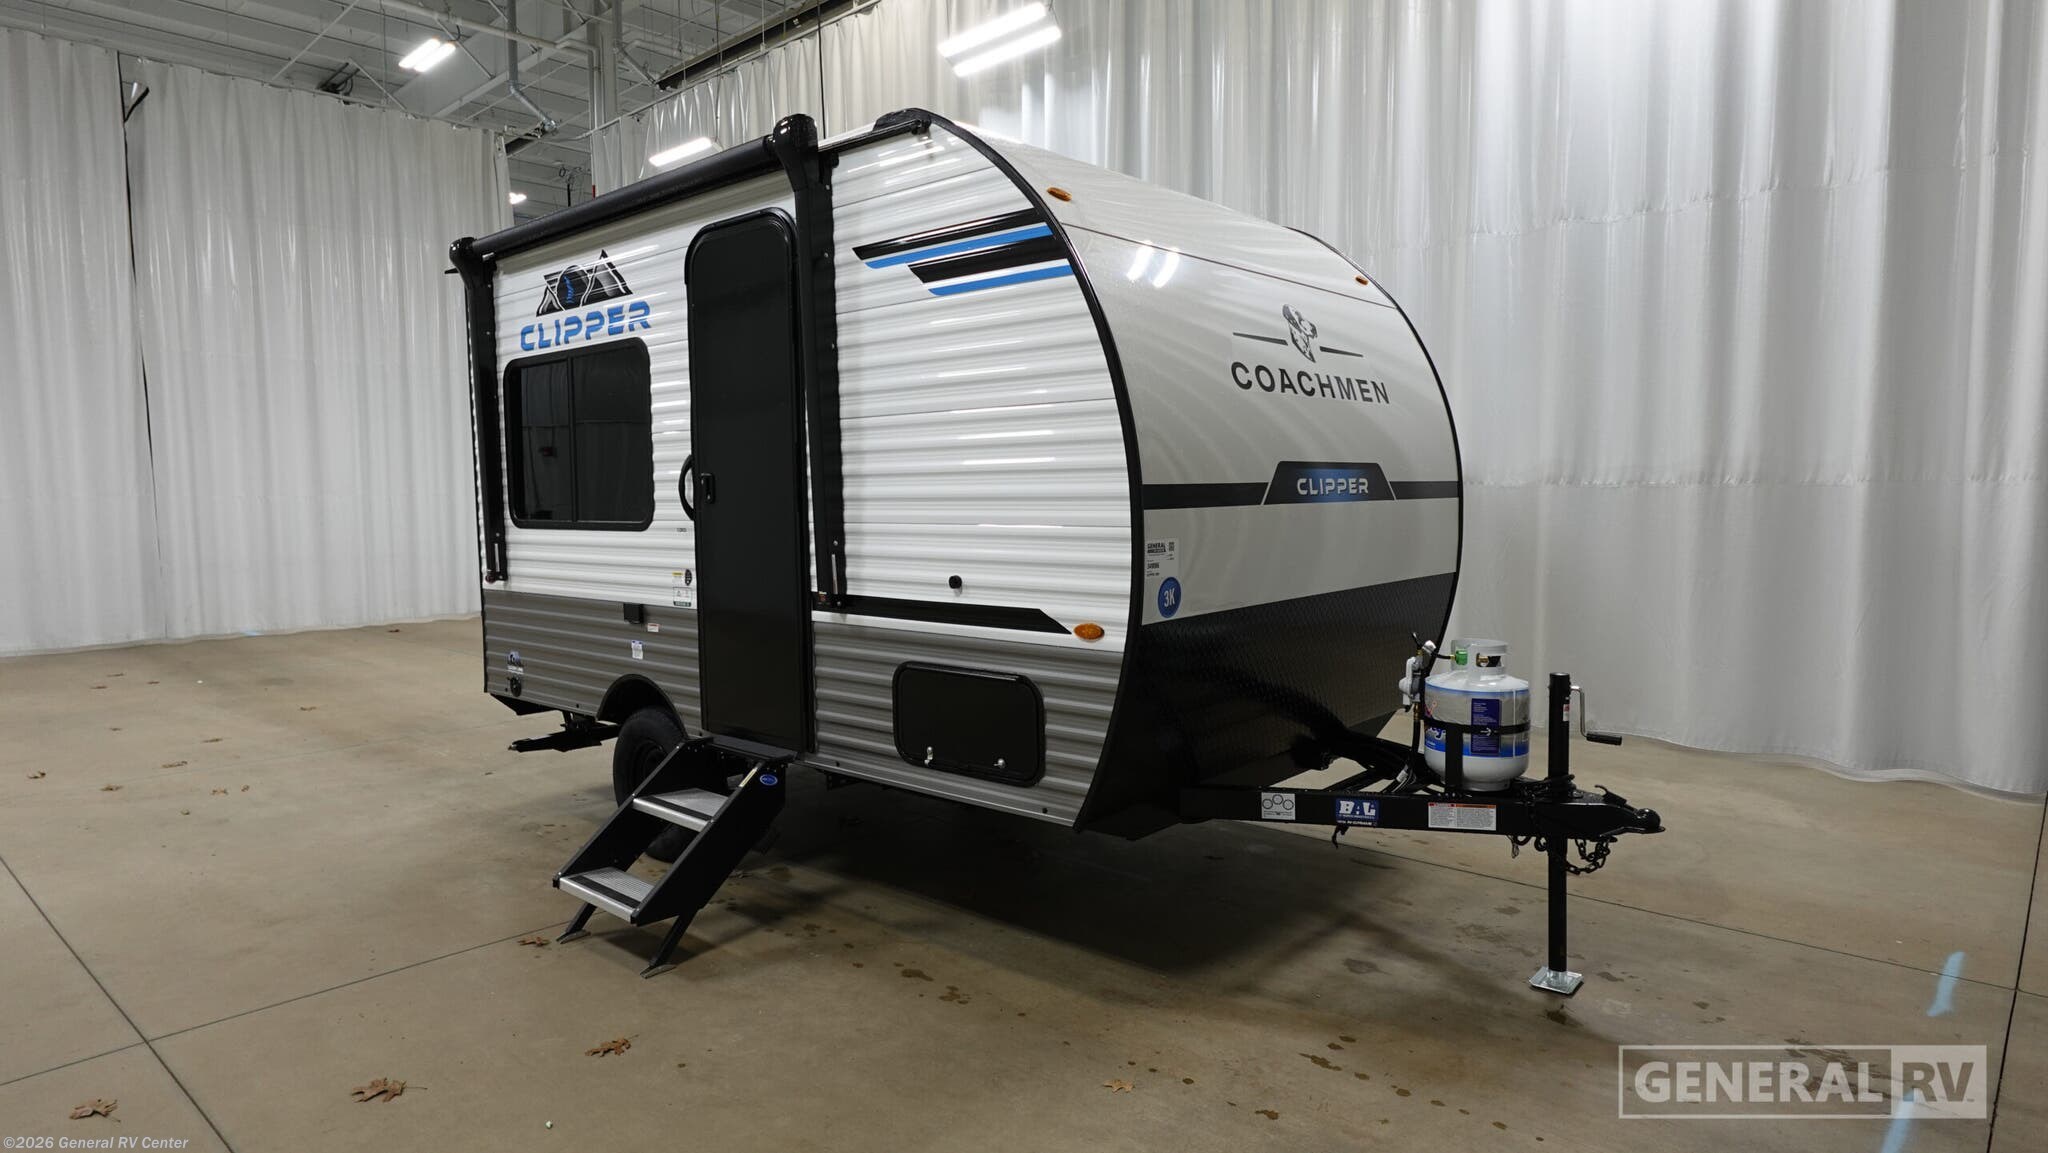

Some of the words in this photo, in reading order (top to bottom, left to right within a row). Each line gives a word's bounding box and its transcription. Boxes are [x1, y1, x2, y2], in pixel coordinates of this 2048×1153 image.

[520, 300, 652, 351] CLIPPER
[1230, 361, 1391, 405] COACHMEN
[1296, 477, 1370, 497] CLIPPER
[1163, 588, 1176, 608] 3K
